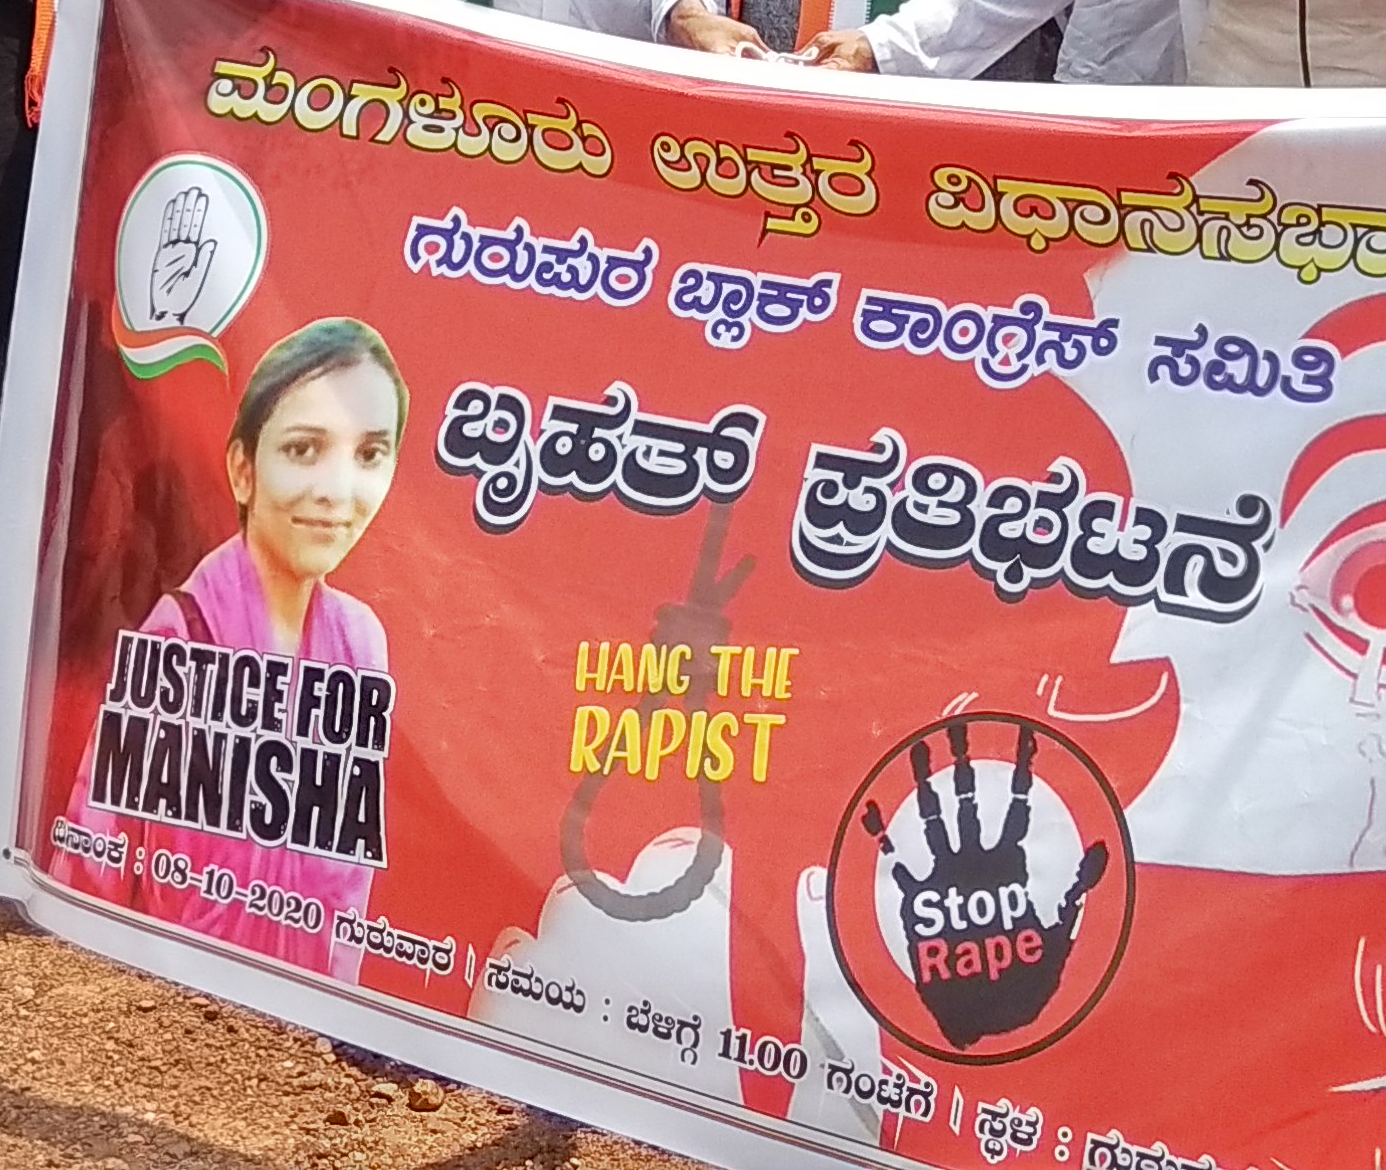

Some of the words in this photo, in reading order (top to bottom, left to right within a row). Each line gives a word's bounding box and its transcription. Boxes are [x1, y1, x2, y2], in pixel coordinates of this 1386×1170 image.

[206, 45, 614, 178] ಮಂಗಳೂರು
[650, 130, 878, 248] ಉತ್ತರ
[407, 209, 656, 304] ಗುರುಪುರ
[671, 266, 836, 345] ಬ್ಲಾಕ್
[857, 297, 1122, 384] ಕಾಂಗ್ರೆಸ್
[1147, 321, 1339, 405] ಸಮಿತಿ
[439, 383, 763, 530] ಬೃಹತ್
[791, 430, 1277, 624] ಪ್ರತಿಭಟನೆ
[112, 633, 290, 733] JUSTICE
[293, 659, 394, 754] FOR
[574, 641, 693, 695] HANG
[710, 643, 801, 700] THE
[89, 707, 388, 867] MANISHA
[569, 706, 789, 783] RAPIST
[914, 882, 1028, 937] Stop
[916, 928, 1045, 983] Rape
[151, 850, 325, 932] 08-10-2020
[486, 957, 587, 1016] ಸಮಯ
[625, 998, 703, 1067] ಬೆಳಿಗ್ಗೆ
[717, 1026, 810, 1081] 11.00
[824, 1056, 937, 1122] ಗಂಟೆಗೆ
